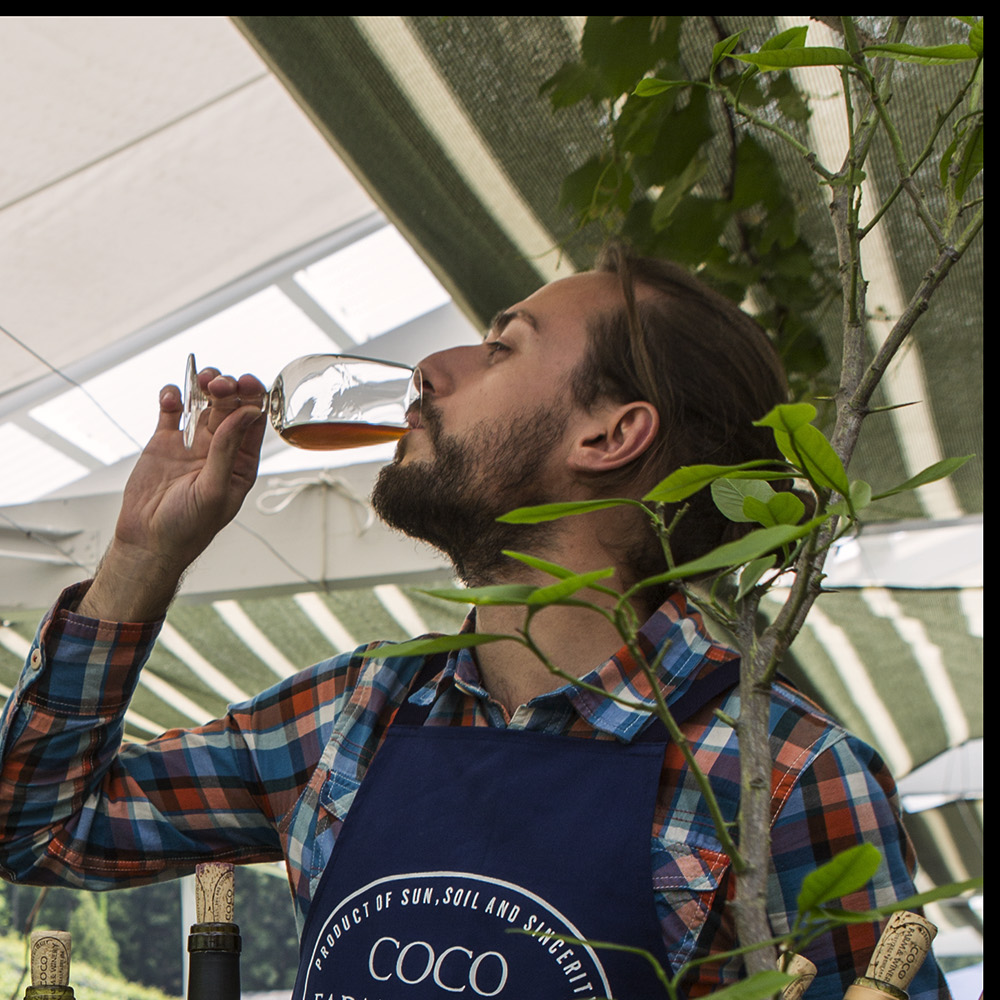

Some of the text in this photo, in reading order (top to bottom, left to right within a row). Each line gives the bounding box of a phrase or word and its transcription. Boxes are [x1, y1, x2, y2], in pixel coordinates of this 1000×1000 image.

[314, 902, 370, 971] PRODUCT
[376, 892, 393, 912] OF
[484, 896, 521, 923] AND
[368, 936, 508, 997] COCO
